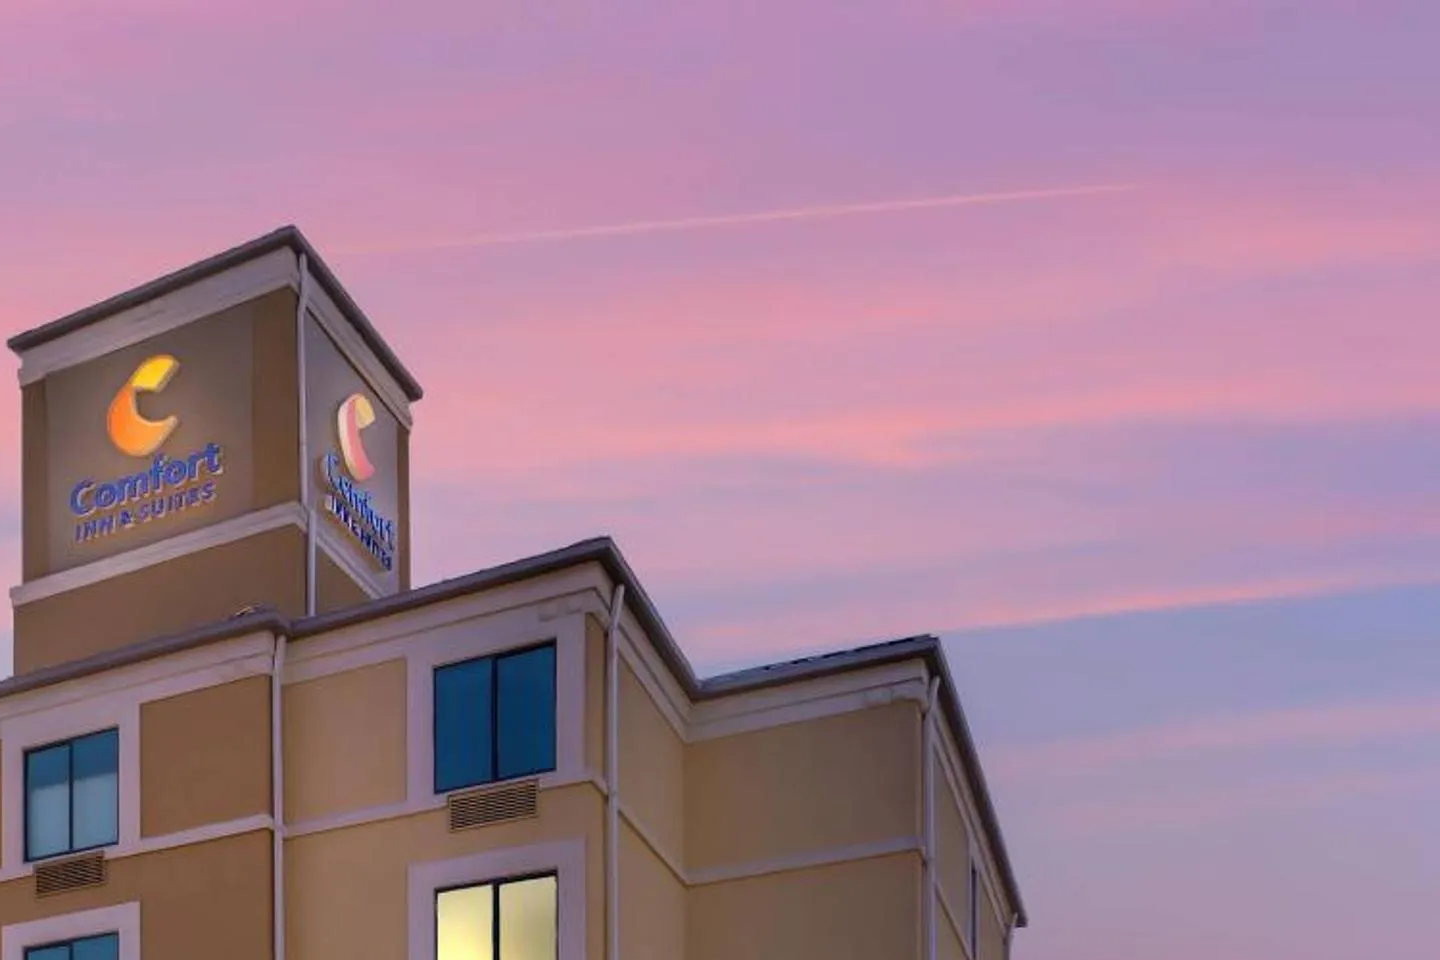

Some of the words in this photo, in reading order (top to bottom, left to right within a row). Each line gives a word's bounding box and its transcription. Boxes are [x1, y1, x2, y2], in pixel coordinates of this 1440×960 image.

[70, 443, 224, 517] Comfort
[75, 515, 117, 543] INN
[120, 509, 135, 528] &
[138, 480, 217, 522] SUITES
